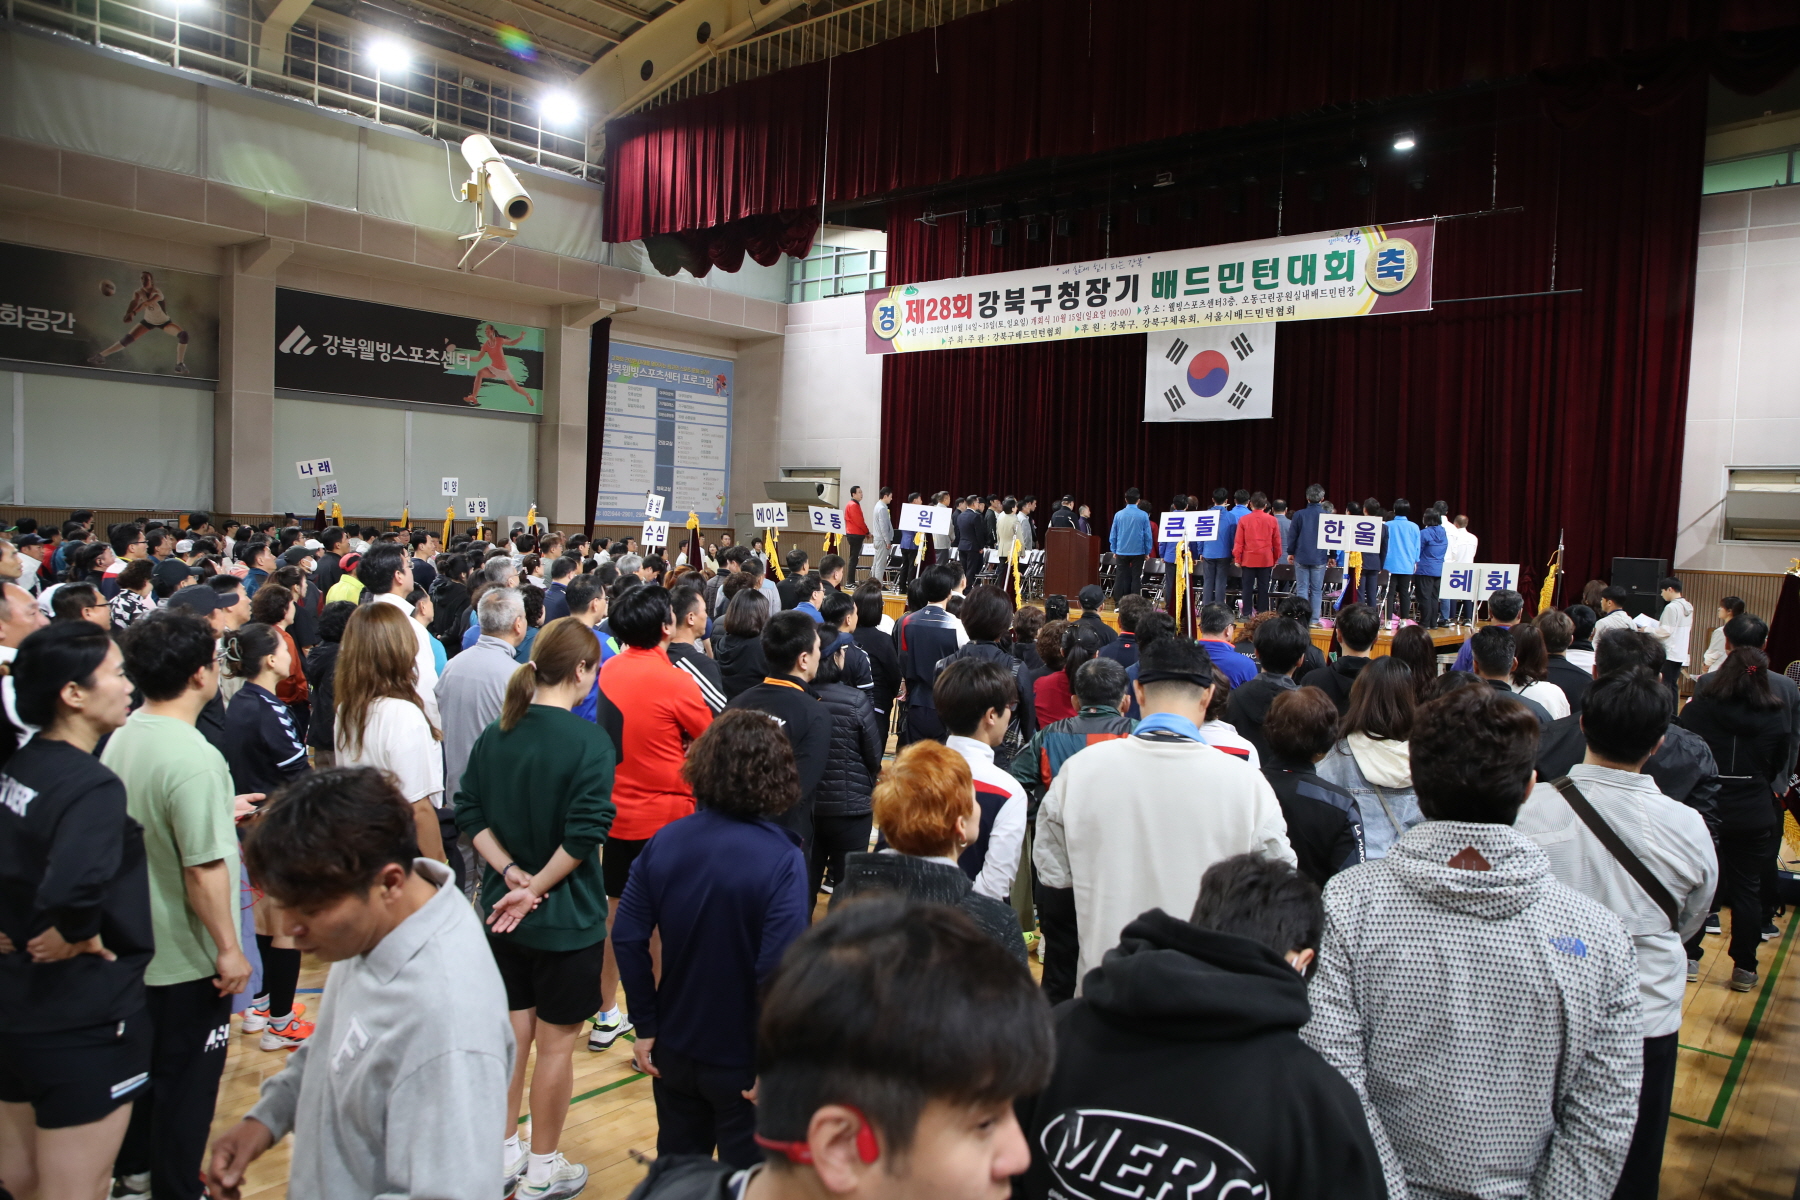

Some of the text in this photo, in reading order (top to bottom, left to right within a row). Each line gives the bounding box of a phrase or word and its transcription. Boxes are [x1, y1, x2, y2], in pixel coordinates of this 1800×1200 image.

[1344, 229, 1362, 245] 강북
[1377, 248, 1405, 282] 축
[905, 249, 1356, 325] 제28회 강북구청장기 배드민턴대회
[0, 303, 77, 335] 화공간
[879, 305, 895, 331] 경
[951, 323, 963, 333] 10월
[1031, 315, 1051, 326] 개회식
[1053, 313, 1067, 324] 10월
[1068, 309, 1107, 322] 15일(일요일
[1108, 307, 1132, 318] 09:00)
[1242, 285, 1356, 304] 오동근린공원실내배드민턴장
[992, 326, 1062, 342] 강북구배드민턴협회
[1204, 304, 1296, 323] 서울시배드민턴협회
[322, 334, 471, 370] 강북웰빙스포츠센터
[682, 373, 714, 389] 프로그램
[756, 506, 785, 523] 에이스
[917, 509, 934, 528] 원
